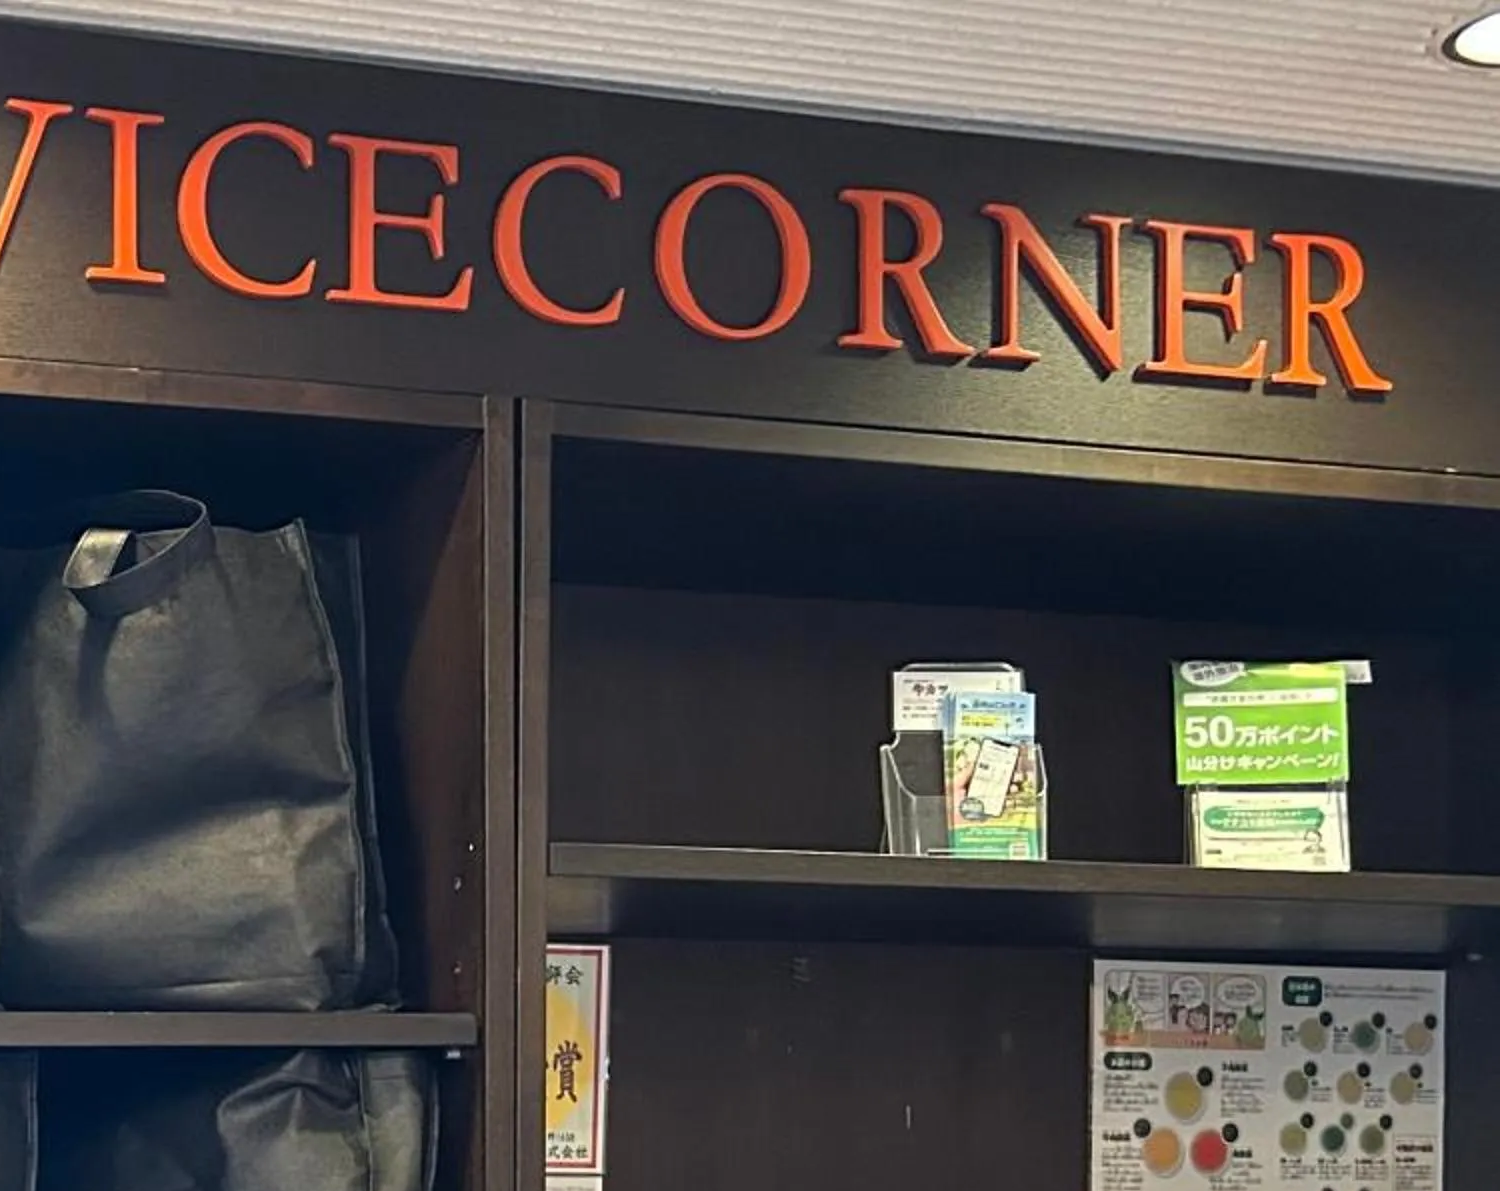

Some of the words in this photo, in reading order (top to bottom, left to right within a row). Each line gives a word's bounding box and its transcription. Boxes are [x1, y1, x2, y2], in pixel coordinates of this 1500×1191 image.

[1185, 715, 1340, 748] 50万ポイント
